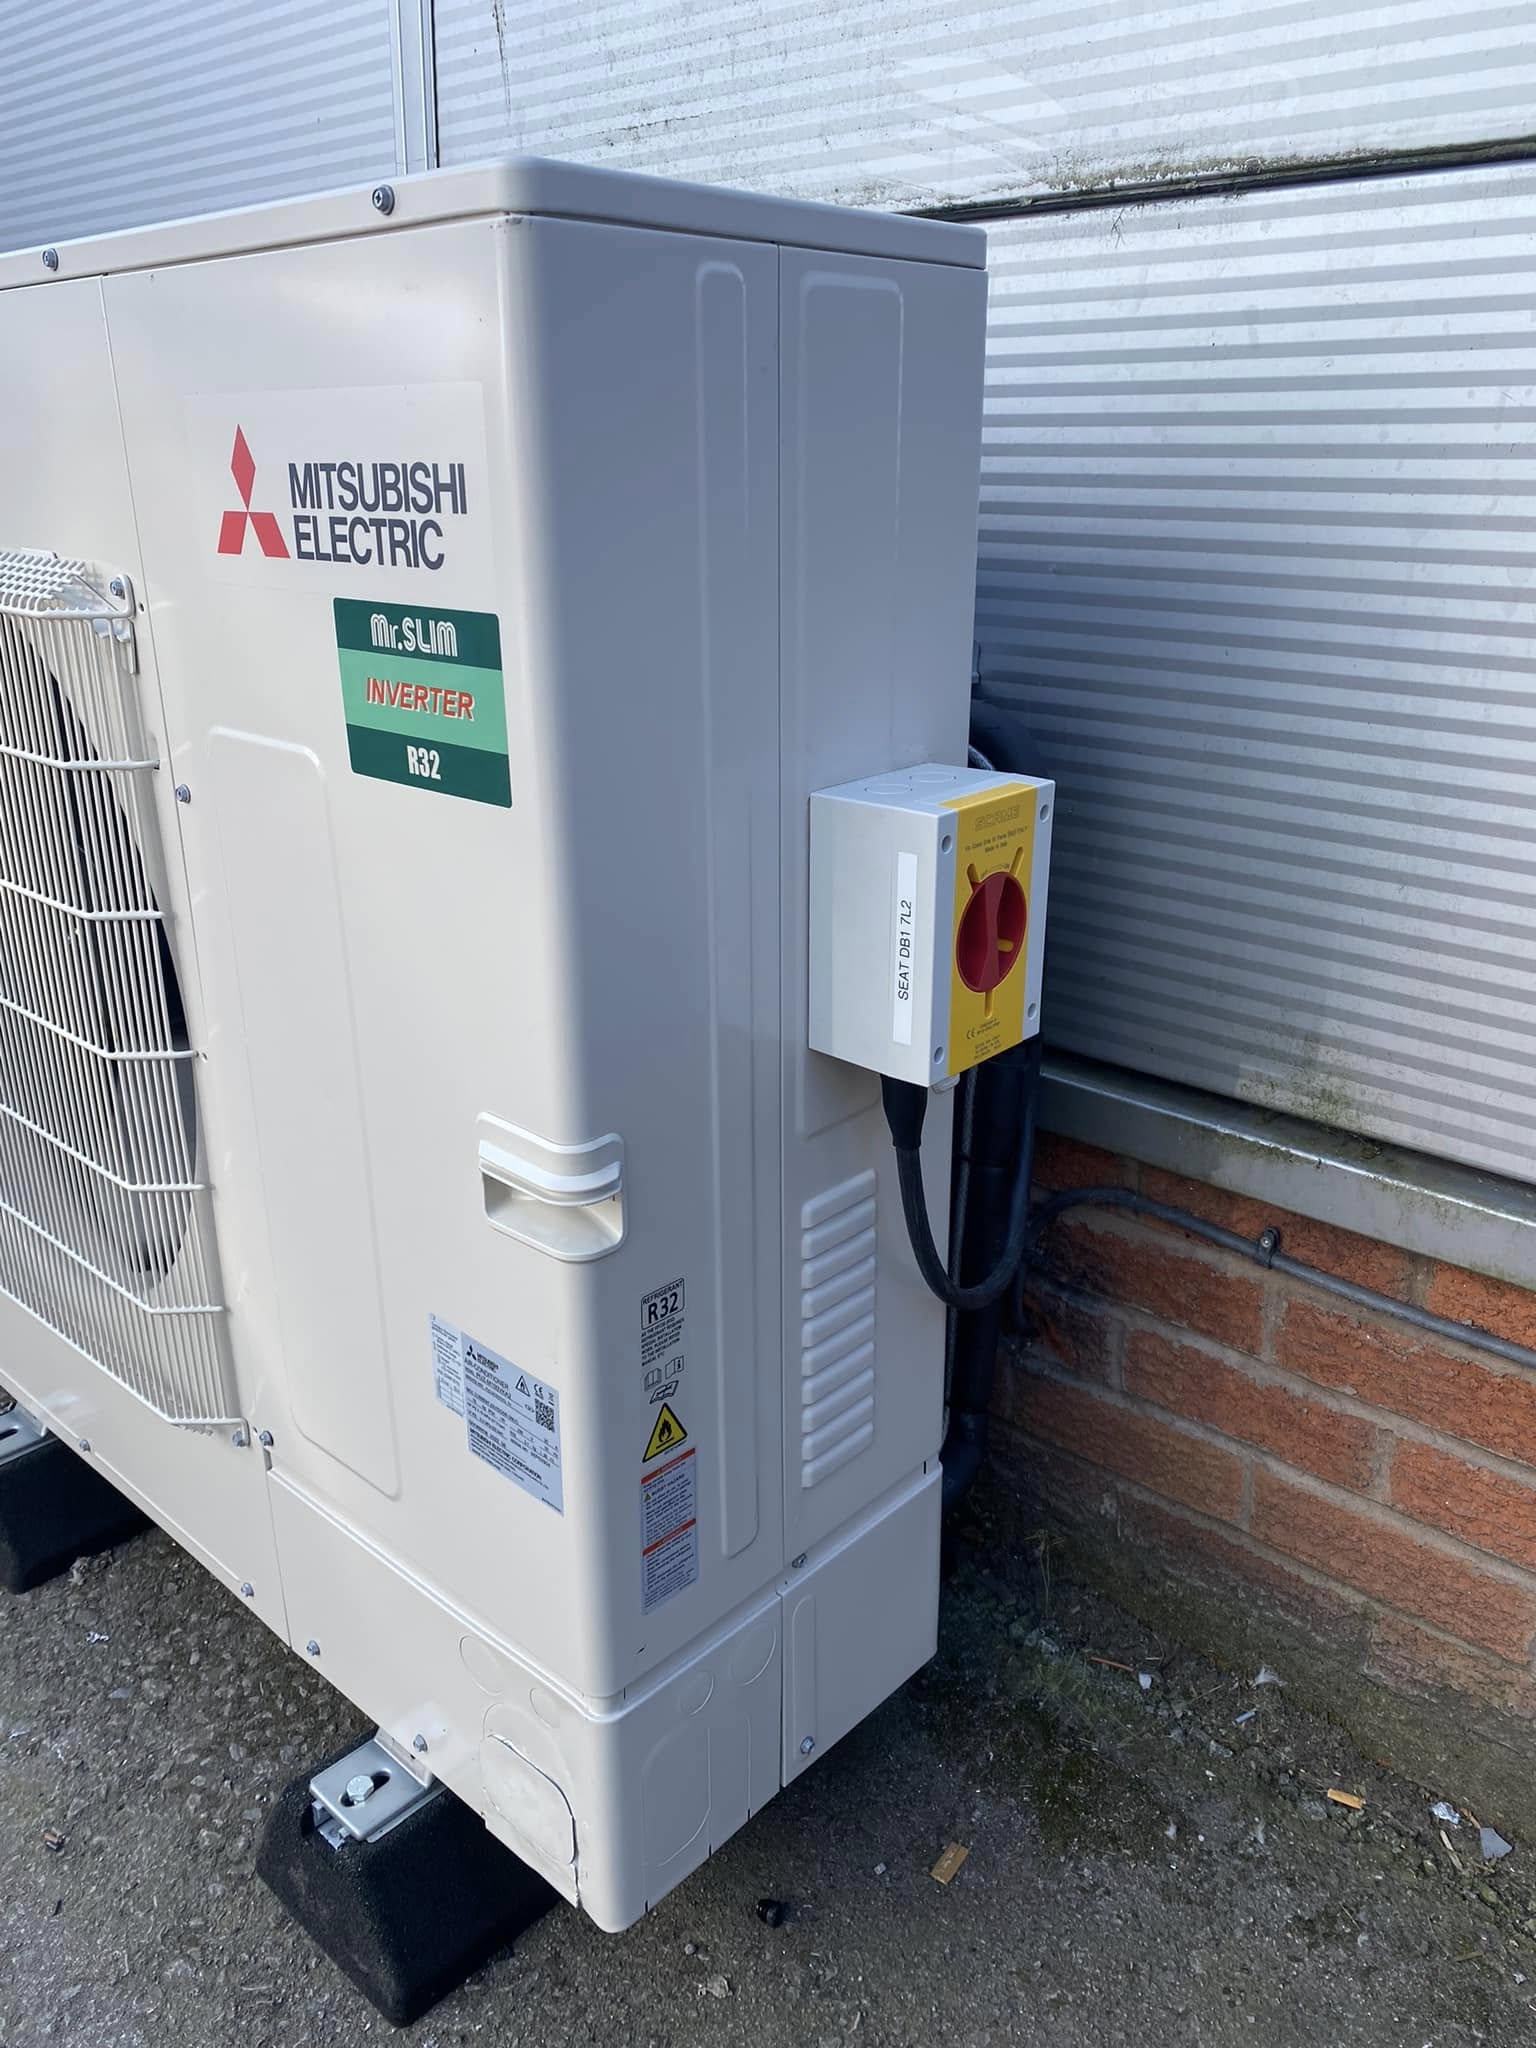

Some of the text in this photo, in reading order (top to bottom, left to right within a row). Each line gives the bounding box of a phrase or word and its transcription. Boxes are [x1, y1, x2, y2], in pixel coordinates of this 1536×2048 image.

[288, 461, 468, 515] MITSUBISHI
[293, 514, 445, 570] ELECTRIC
[366, 677, 476, 722] INVERTER
[406, 746, 442, 780] R32
[898, 899, 912, 1001] SEAT DB1 7L2
[642, 1280, 683, 1305] REFRIGERANT
[648, 1291, 679, 1324] R32
